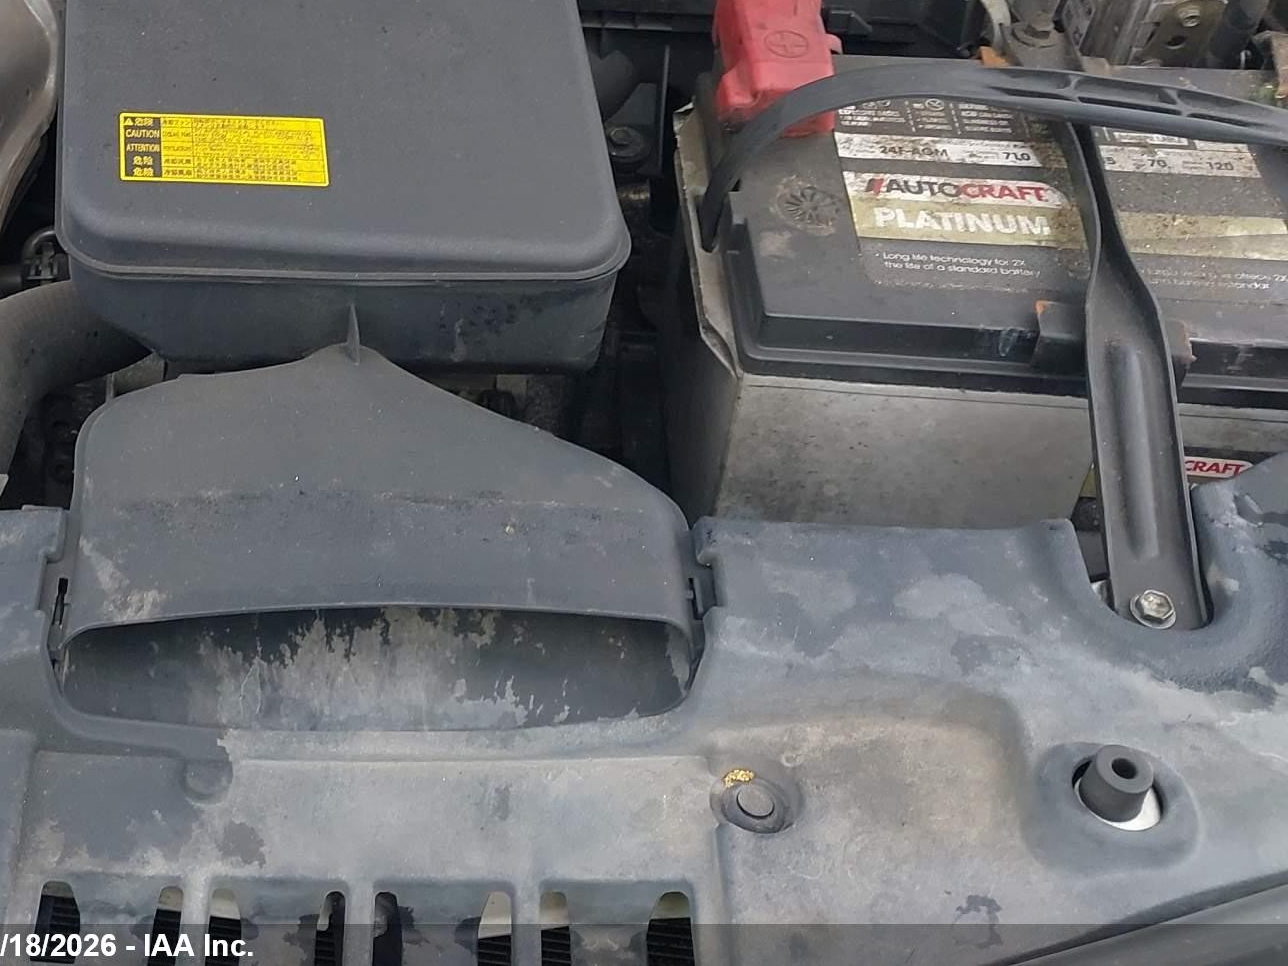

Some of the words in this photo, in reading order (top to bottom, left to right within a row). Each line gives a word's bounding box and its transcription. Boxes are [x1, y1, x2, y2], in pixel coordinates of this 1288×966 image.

[125, 129, 160, 138] CAUTION
[126, 143, 160, 152] ATTENTION
[879, 145, 948, 157] 24F-AGM
[1206, 161, 1234, 171] 120
[886, 178, 1049, 202] AUTOCRAFT
[873, 207, 1051, 236] PLATINUM
[882, 252, 910, 262] Long
[930, 254, 992, 266] technology
[947, 265, 998, 275] standard
[999, 267, 1041, 278] battery
